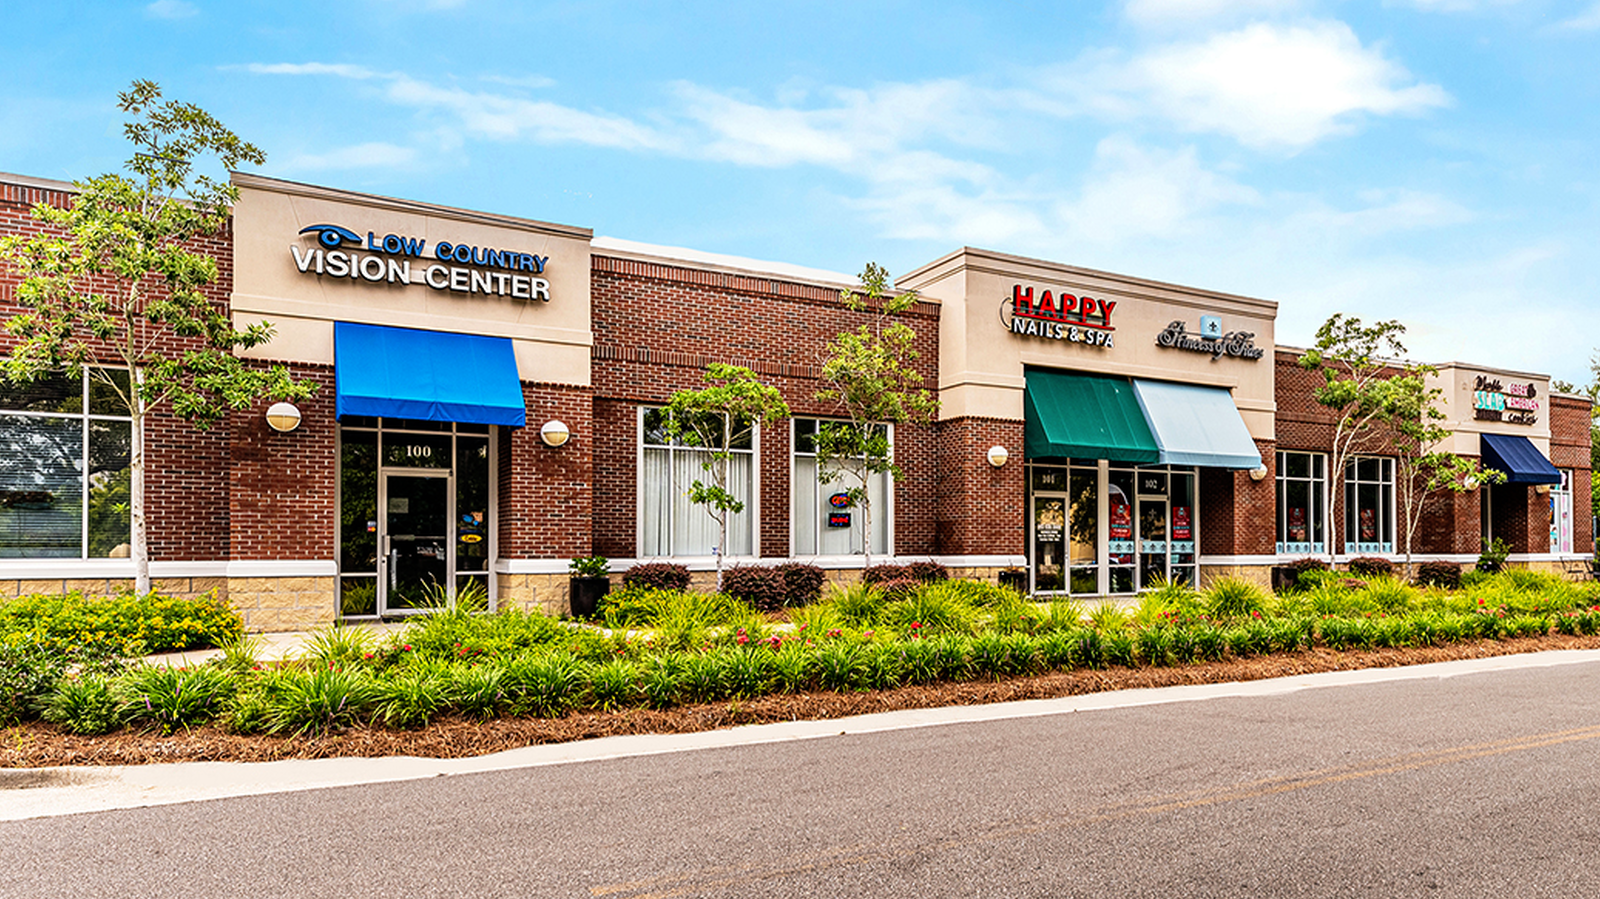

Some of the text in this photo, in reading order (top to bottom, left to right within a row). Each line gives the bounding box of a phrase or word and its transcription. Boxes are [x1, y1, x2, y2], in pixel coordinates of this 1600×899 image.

[366, 231, 549, 273] LOW COUNTRY
[290, 245, 551, 302] VISION CENTER
[1013, 285, 1117, 326] HAPPY
[1012, 317, 1114, 348] NAILS & SPA
[1476, 390, 1505, 411] SLAB
[406, 445, 431, 458] 100
